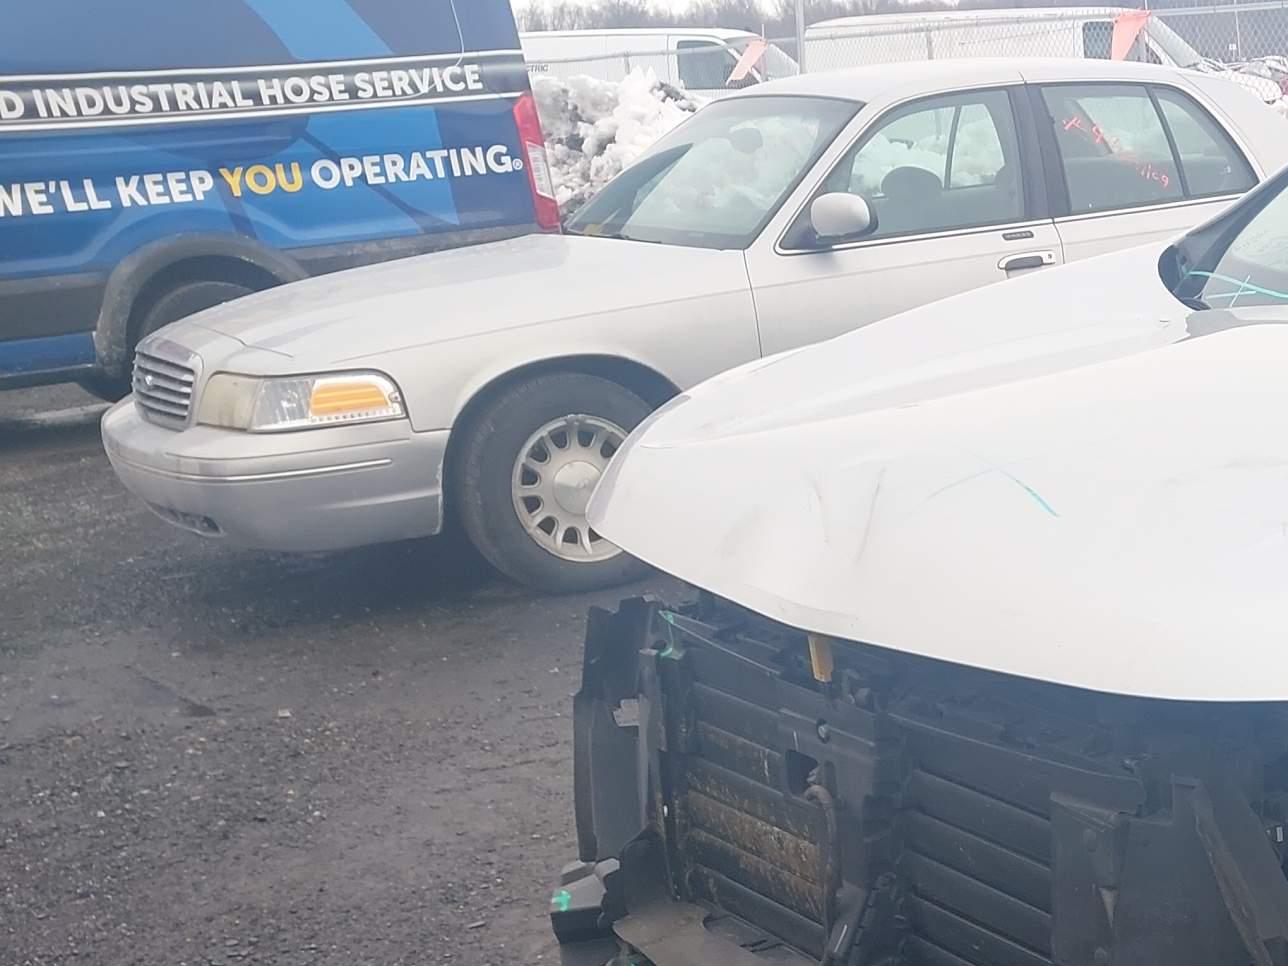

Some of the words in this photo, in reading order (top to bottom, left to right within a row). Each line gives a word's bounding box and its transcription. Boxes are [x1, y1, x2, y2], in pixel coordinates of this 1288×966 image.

[0, 90, 24, 118] D
[32, 80, 254, 118] INDUSTRIAL
[257, 73, 349, 105] HOSE
[354, 64, 483, 98] SERVICE
[115, 170, 214, 208] KEEP
[219, 162, 304, 197] YOU
